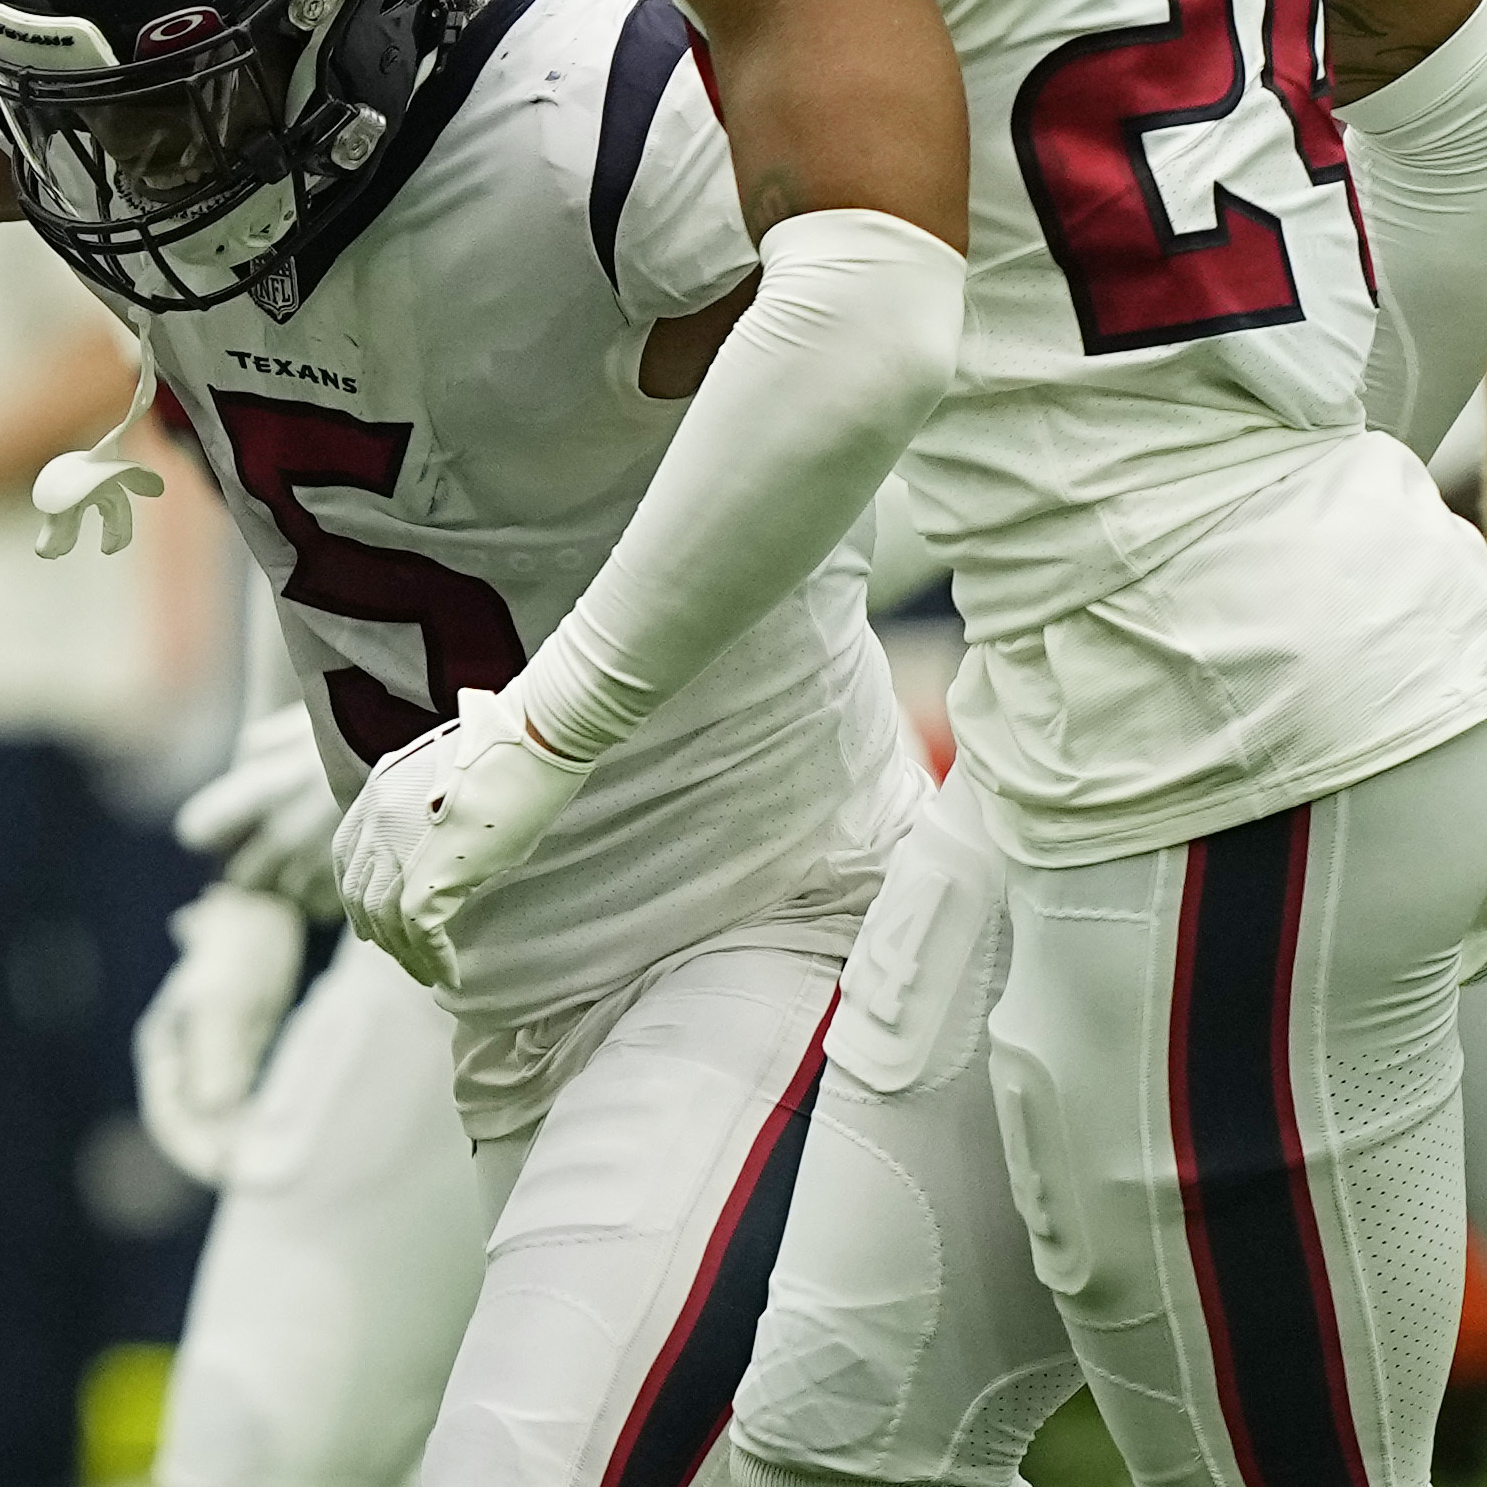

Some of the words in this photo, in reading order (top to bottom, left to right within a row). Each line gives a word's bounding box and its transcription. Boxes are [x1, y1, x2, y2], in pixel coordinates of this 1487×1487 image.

[256, 275, 292, 306] NFL
[227, 350, 358, 395] TEXANS
[208, 383, 529, 770] 5
